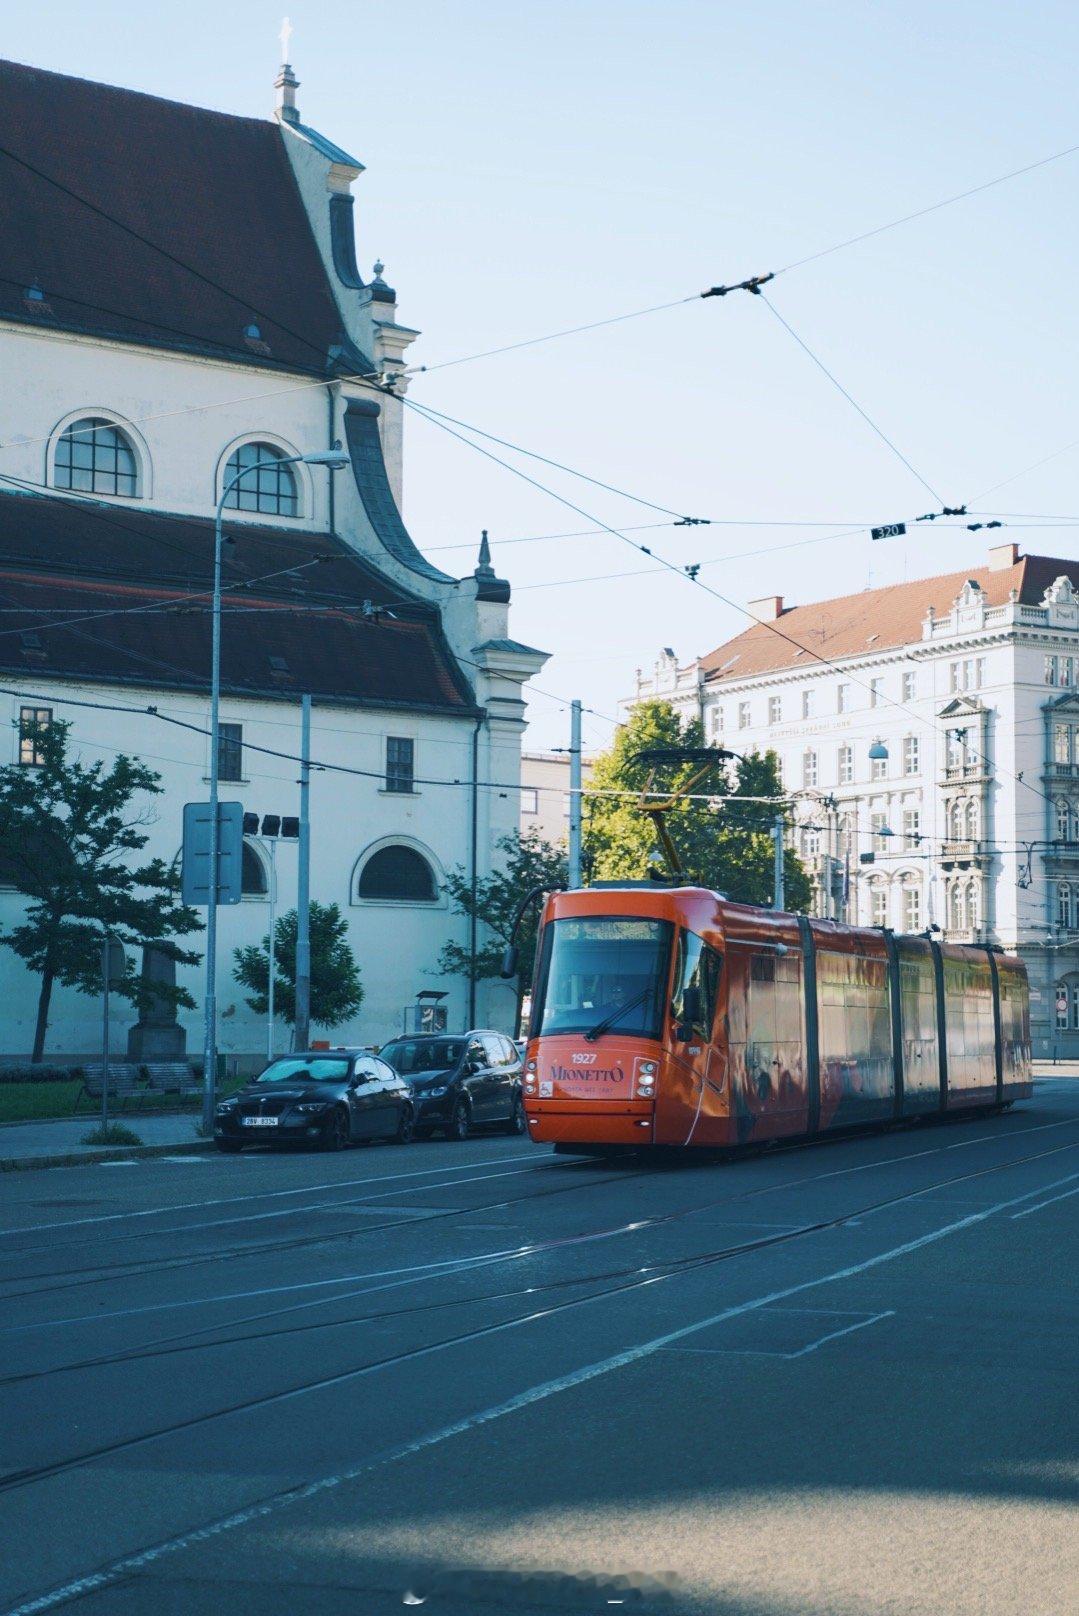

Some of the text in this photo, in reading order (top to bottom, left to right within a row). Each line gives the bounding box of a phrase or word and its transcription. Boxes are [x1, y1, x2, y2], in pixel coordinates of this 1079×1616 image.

[878, 525, 899, 539] 320
[571, 1053, 597, 1064] 1927
[551, 1065, 624, 1083] MIONETTO
